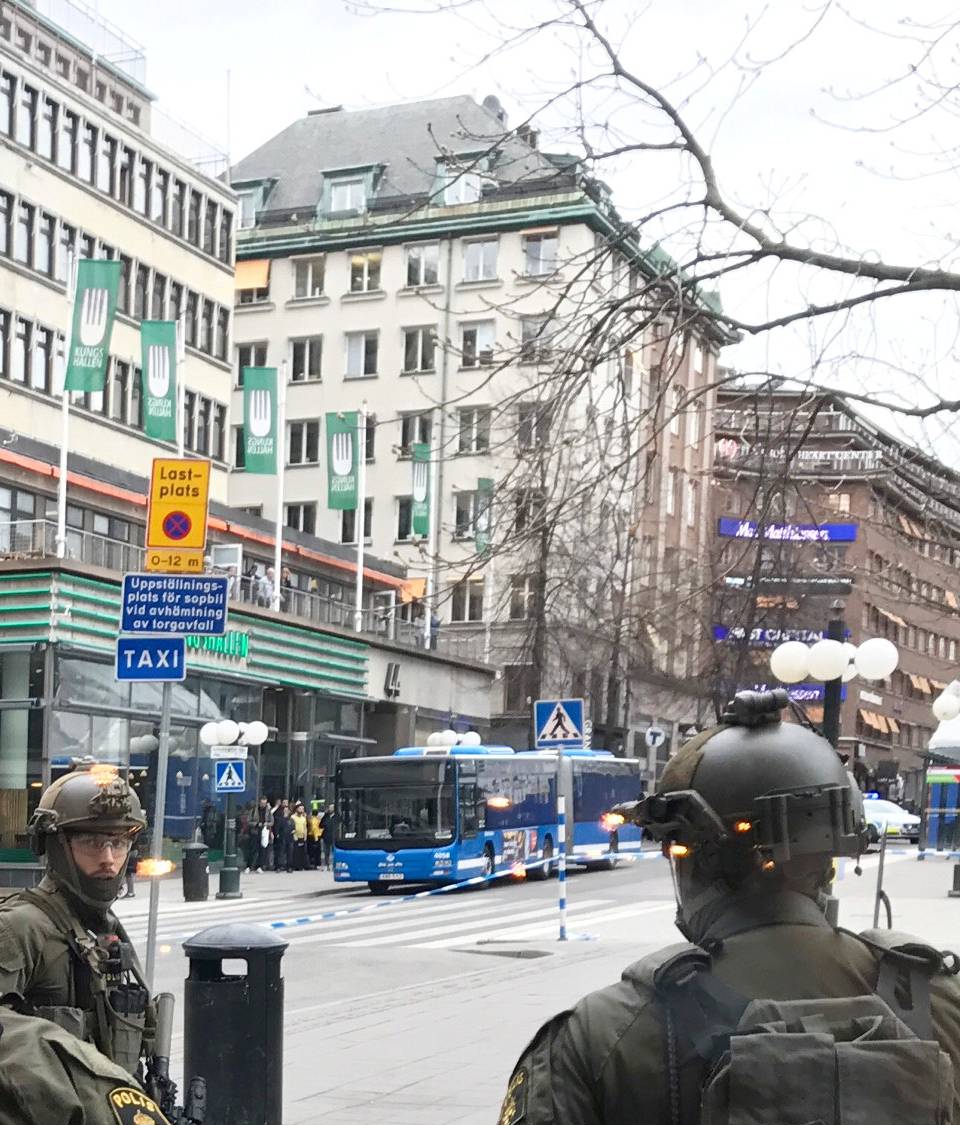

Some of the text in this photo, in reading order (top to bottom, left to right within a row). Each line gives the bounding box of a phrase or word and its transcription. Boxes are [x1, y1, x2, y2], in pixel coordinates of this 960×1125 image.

[74, 347, 104, 358] KUNGS
[72, 357, 102, 368] HALLEN
[160, 467, 202, 480] Last-
[160, 483, 200, 499] plats
[151, 554, 199, 567] 0-12 m
[131, 577, 223, 592] Uppställnings-
[127, 590, 224, 606] plats för sopbil
[126, 605, 224, 620] vid avhämtning
[133, 619, 214, 632] av torgavfall
[123, 649, 179, 669] TAXI
[112, 1092, 156, 1112] POLIS
